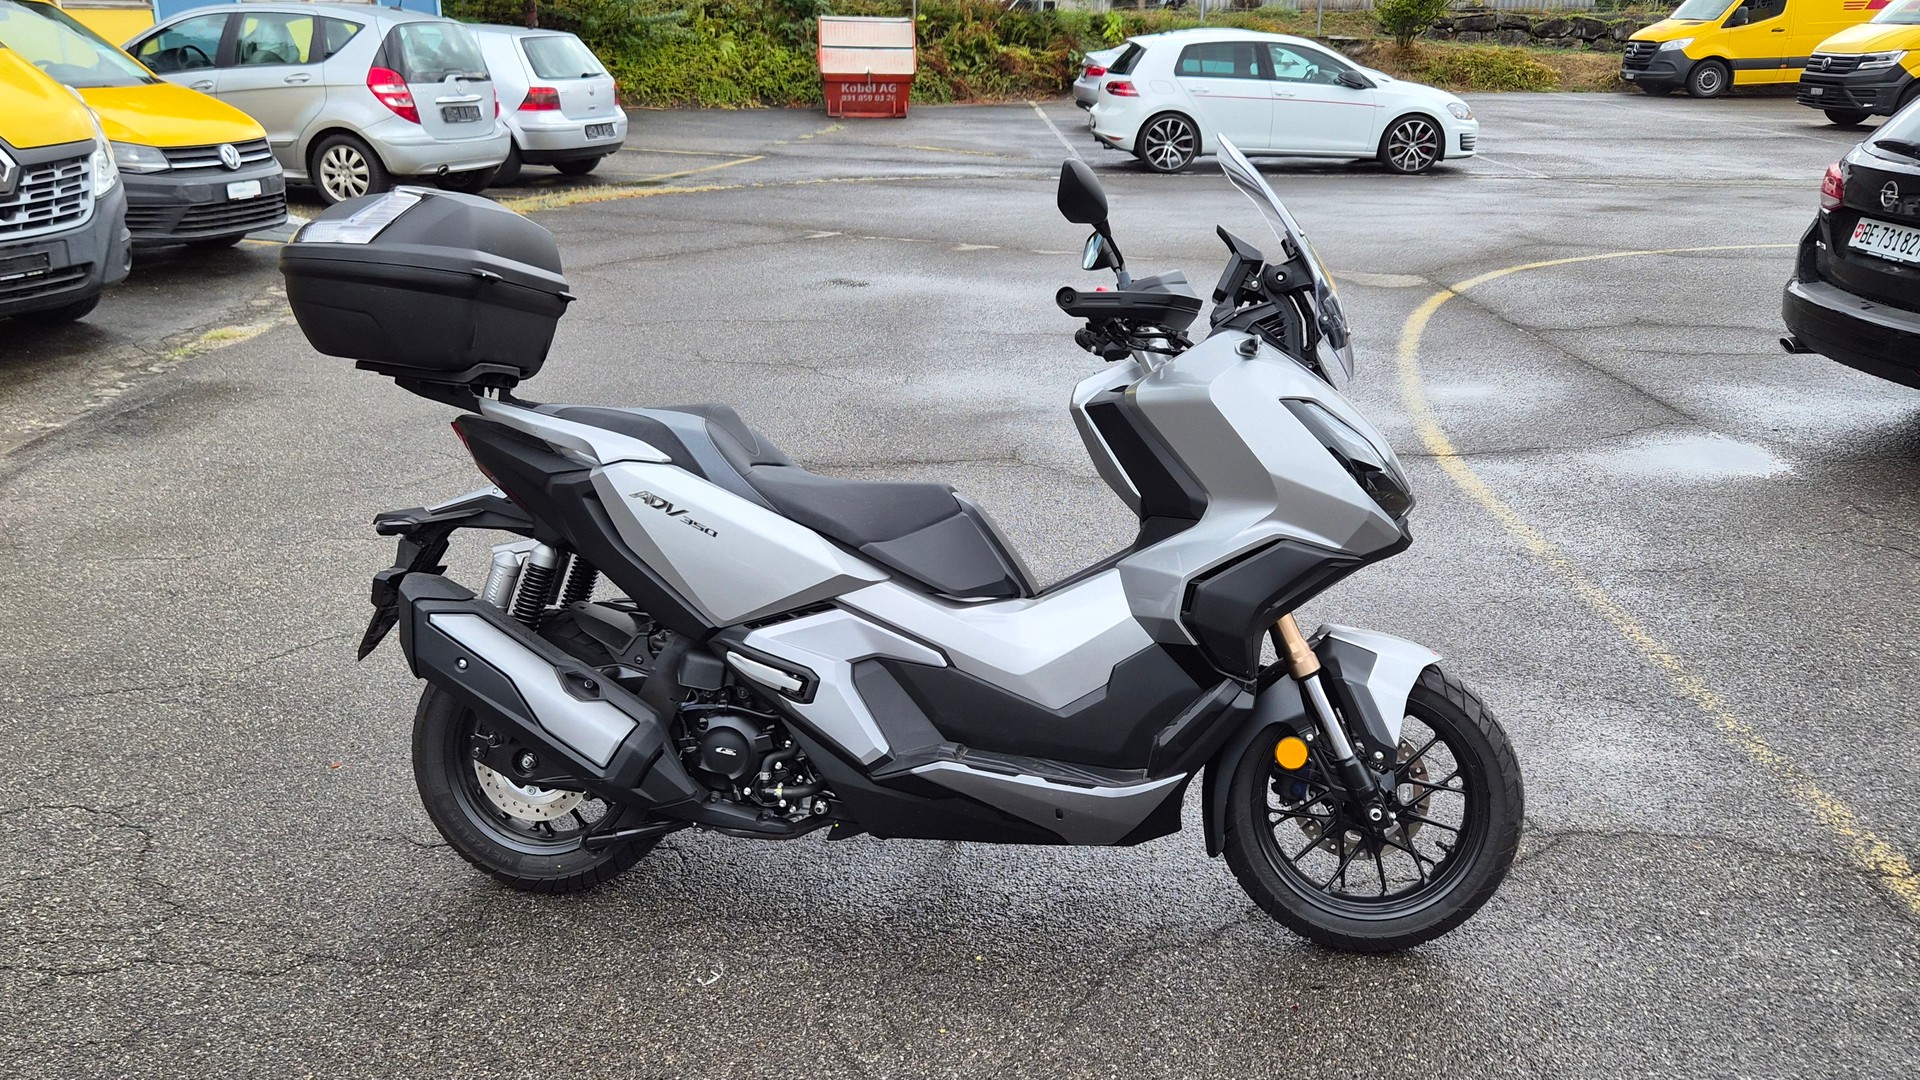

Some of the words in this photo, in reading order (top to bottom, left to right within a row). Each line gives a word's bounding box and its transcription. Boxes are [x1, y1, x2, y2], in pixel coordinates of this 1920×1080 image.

[841, 83, 877, 93] Kobel
[880, 83, 897, 93] AG
[841, 94, 856, 102] 031
[628, 490, 690, 518] ADV
[680, 515, 719, 538] 350
